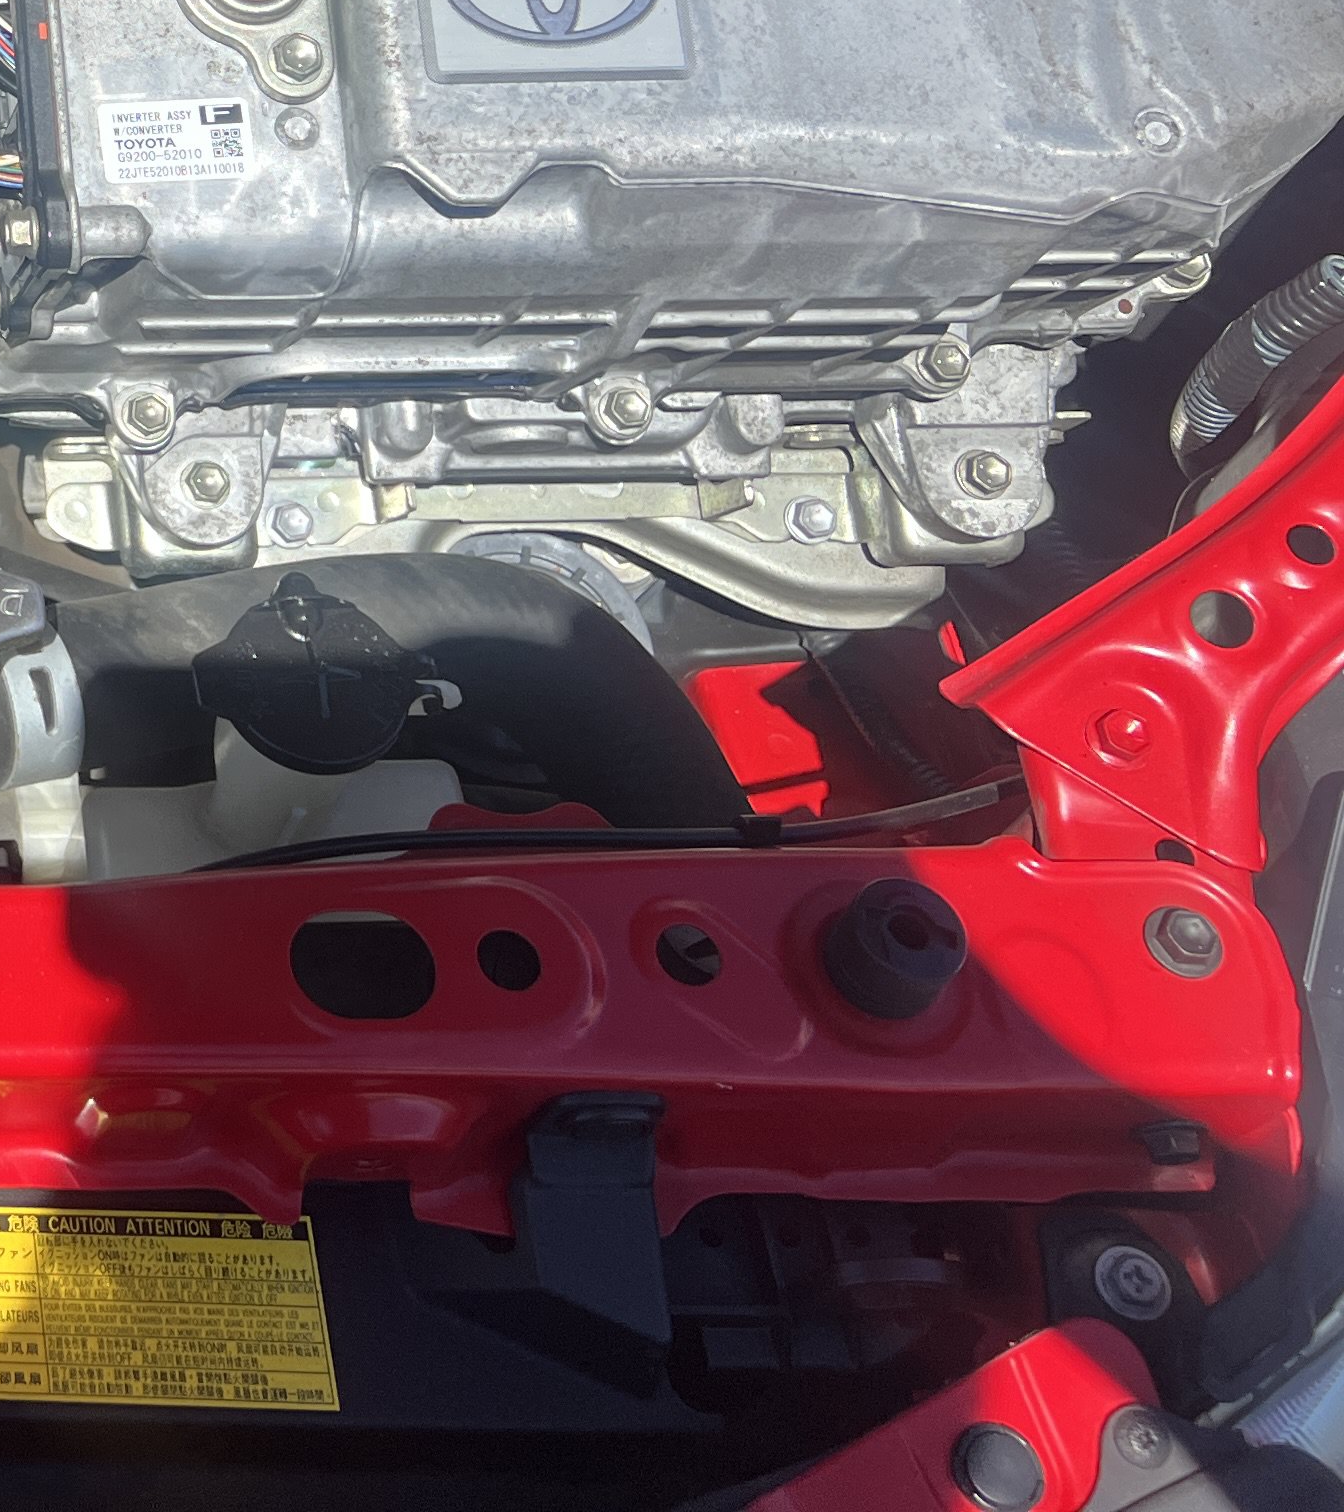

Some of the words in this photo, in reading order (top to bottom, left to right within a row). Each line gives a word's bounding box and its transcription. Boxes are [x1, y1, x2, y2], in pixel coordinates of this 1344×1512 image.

[112, 112, 161, 122] INVERTER
[167, 110, 191, 120] ASSY
[204, 105, 234, 123] F
[114, 124, 182, 136] W/CONVERTER
[114, 137, 176, 149] TOYOTA
[118, 149, 202, 162] G9200-52010
[48, 1216, 116, 1233] CAUTION
[124, 1218, 211, 1236] ATTENTION
[14, 1280, 36, 1292] FANS
